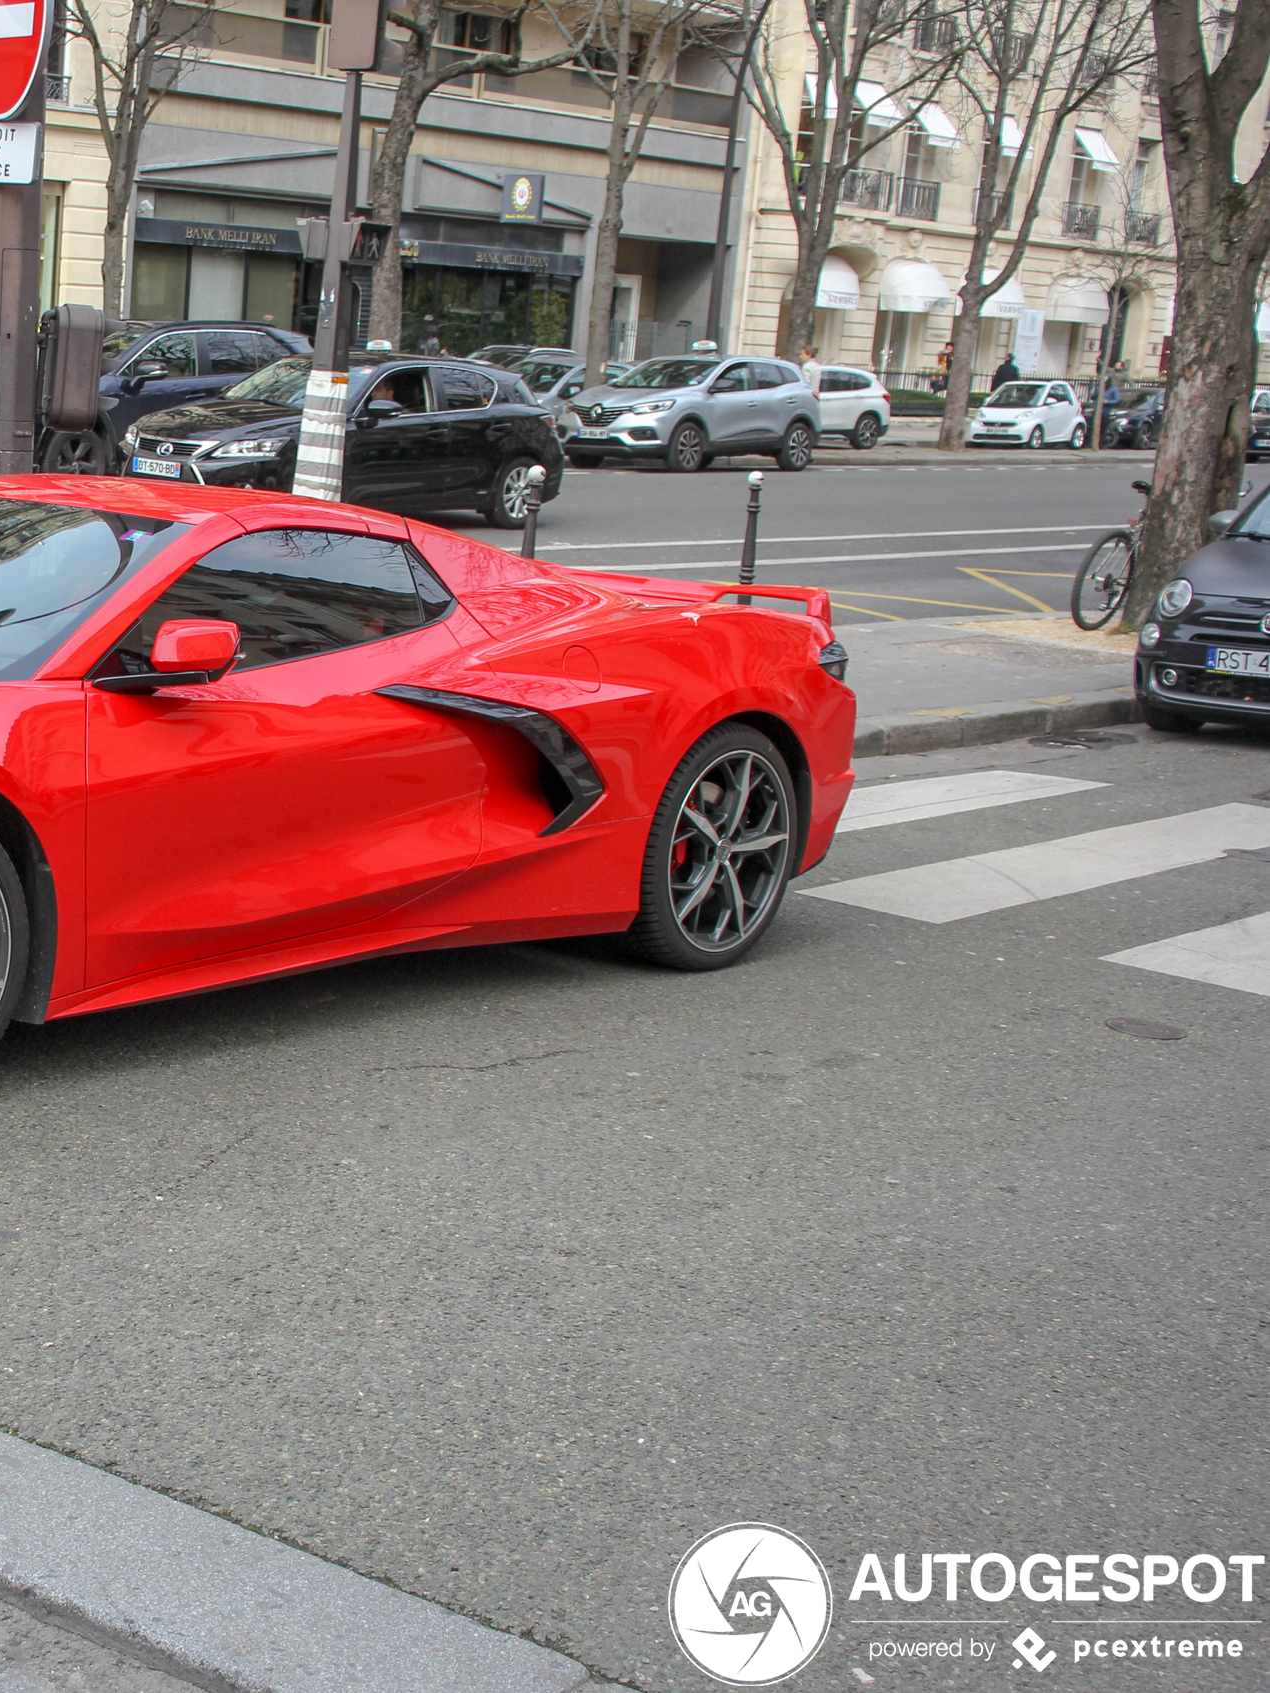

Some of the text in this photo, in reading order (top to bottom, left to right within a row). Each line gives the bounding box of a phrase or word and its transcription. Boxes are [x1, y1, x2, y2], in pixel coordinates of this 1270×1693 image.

[185, 227, 277, 245] BANK MELLI IRAN
[475, 251, 549, 268] BANK MELLI IRAN
[1217, 650, 1254, 671] RST
